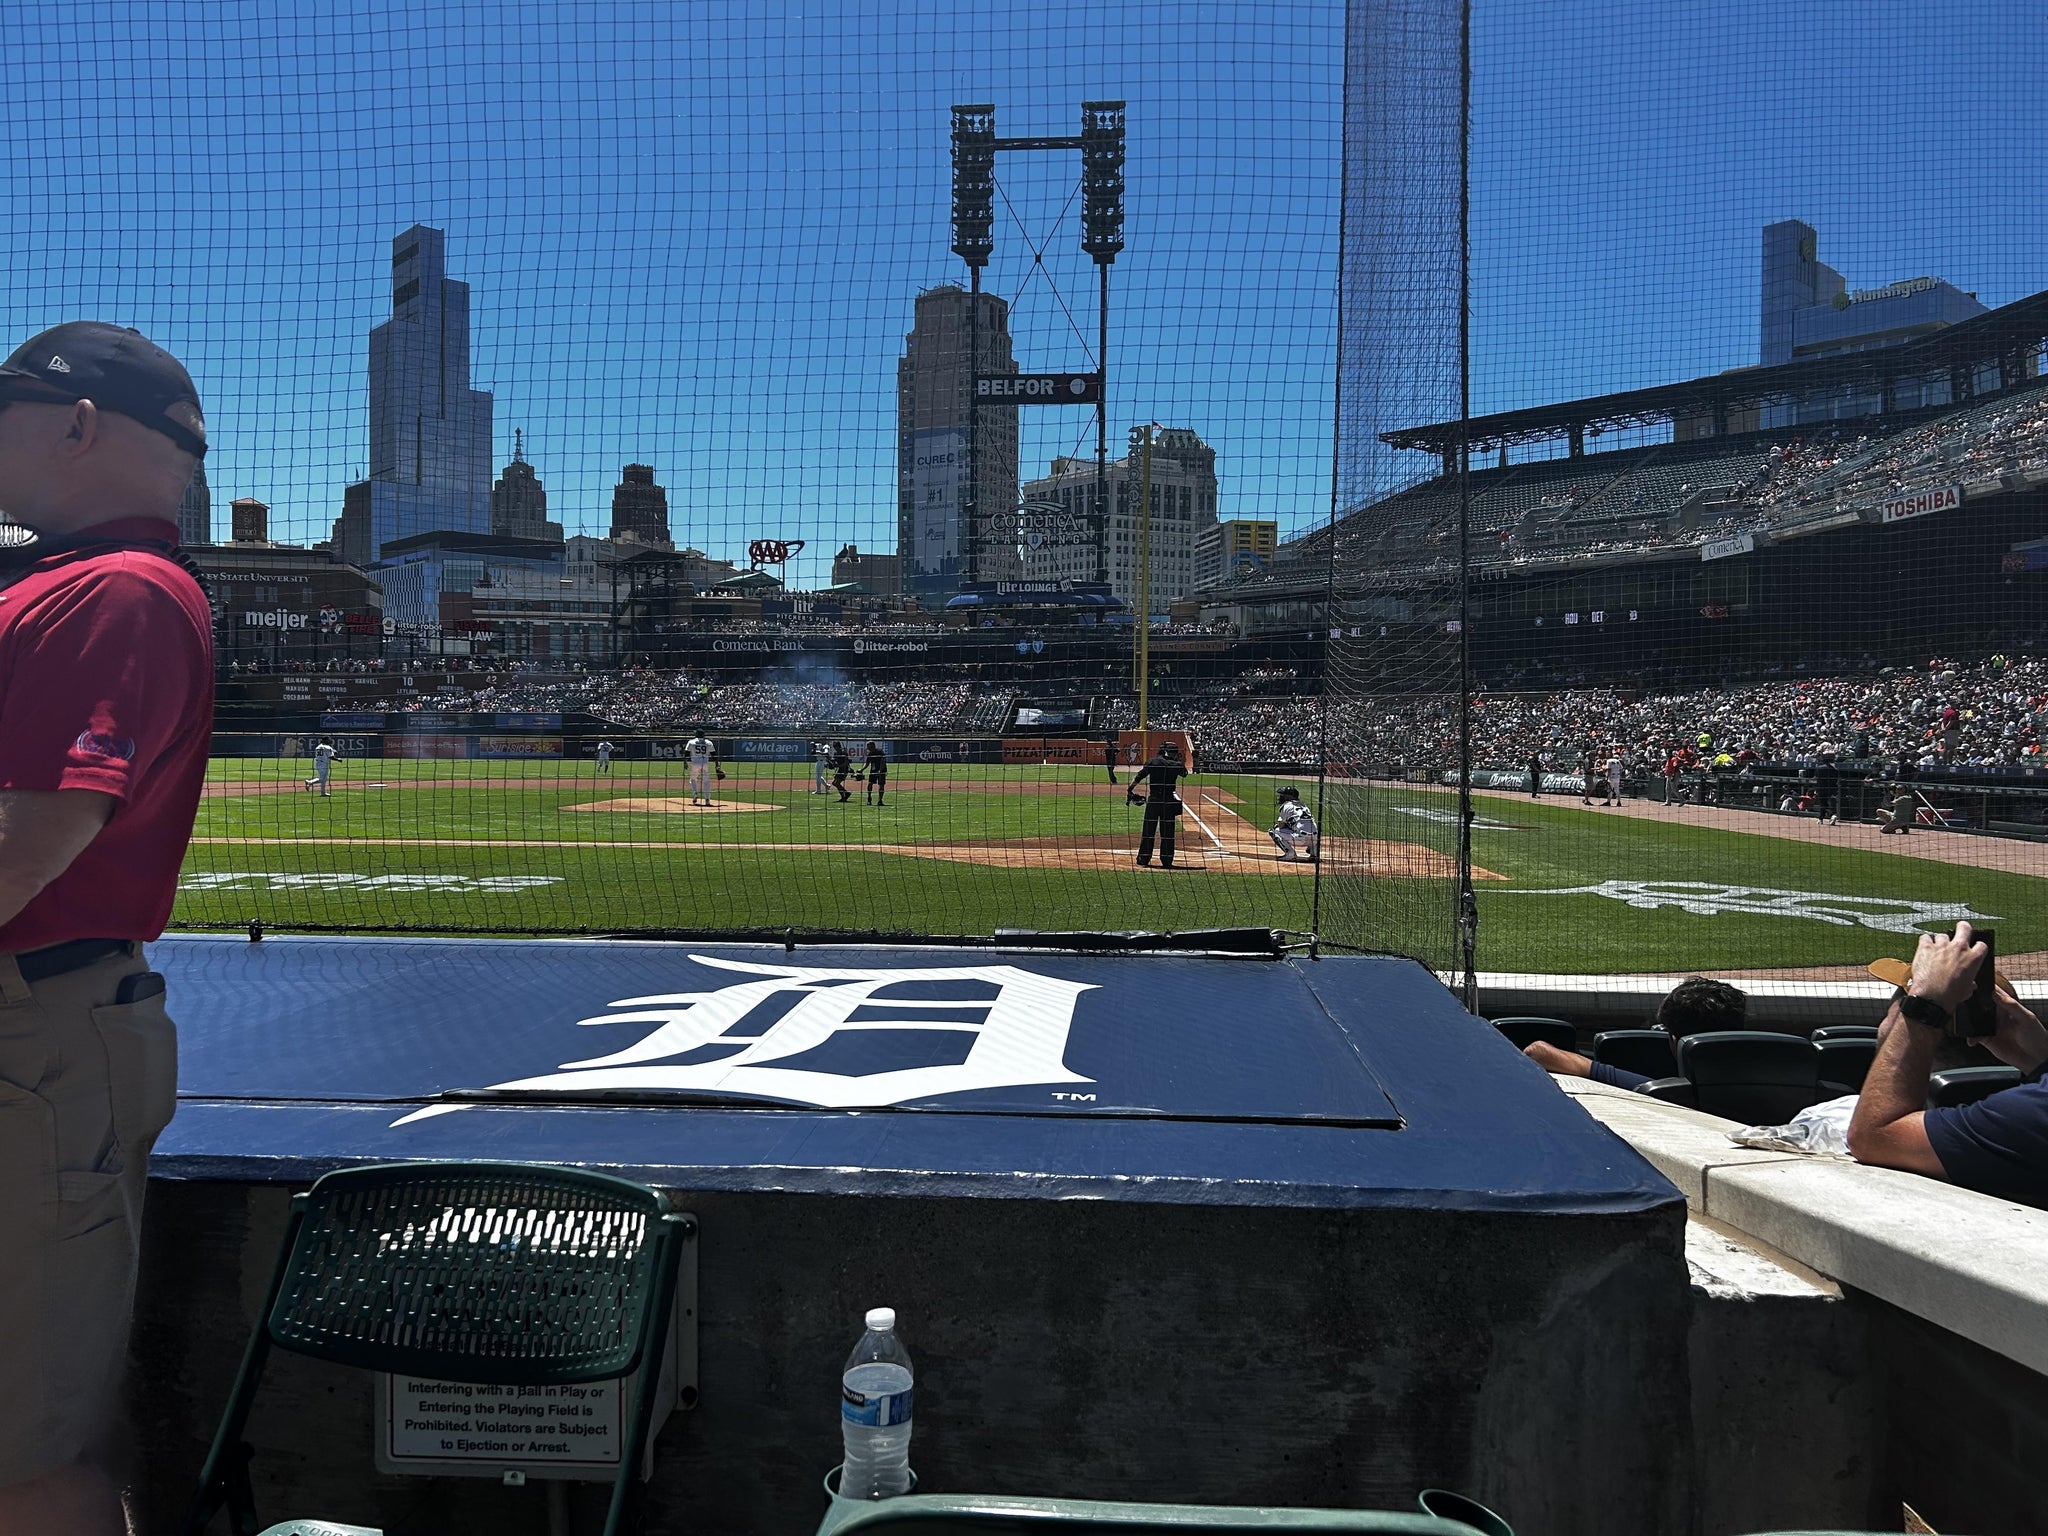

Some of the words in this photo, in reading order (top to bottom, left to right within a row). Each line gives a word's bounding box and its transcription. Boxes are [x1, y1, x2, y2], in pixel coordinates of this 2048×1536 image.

[1852, 276, 1937, 305] Huntington
[977, 378, 1055, 396] BELFOR
[929, 488, 942, 502] #1
[1885, 489, 1957, 518] TOSHIBA
[749, 540, 788, 564] AAA
[1481, 569, 1508, 580] CLUB
[1019, 583, 1057, 592] LOUNGE
[245, 608, 308, 631] meijer
[344, 614, 381, 624] BELLE
[1564, 612, 1578, 625] HOU
[1592, 610, 1604, 623] DET
[468, 630, 493, 641] LAW
[773, 640, 805, 651] Bank
[865, 640, 929, 652] litter-robot
[402, 676, 413, 686] 10
[446, 675, 455, 684] 11
[486, 676, 498, 685] 42
[308, 738, 365, 750] FRRIS
[695, 745, 707, 754] 59
[757, 742, 798, 753] McLaren
[919, 750, 951, 761] Corona
[1003, 746, 1042, 758] PIZZA!
[1045, 746, 1082, 758] PIZZA!
[179, 872, 566, 887] TORS
[1051, 1092, 1096, 1101] TM
[408, 1382, 472, 1397] Interfering
[476, 1383, 502, 1396] with
[506, 1387, 514, 1397] a
[517, 1384, 541, 1397] Ball
[545, 1384, 556, 1397] in
[561, 1385, 586, 1400] Play
[591, 1388, 604, 1397] or
[419, 1400, 472, 1415] Entering
[475, 1402, 495, 1414] the
[498, 1403, 545, 1418] Playing
[549, 1404, 578, 1416] Field
[582, 1405, 593, 1416] is
[405, 1419, 472, 1432] Prohibited.
[476, 1421, 532, 1434] Violators
[535, 1424, 556, 1434] are
[559, 1422, 607, 1437] Subject
[441, 1438, 453, 1449] to
[457, 1438, 508, 1453] Ejection
[512, 1441, 525, 1451] or
[528, 1440, 571, 1453] Arrest.
